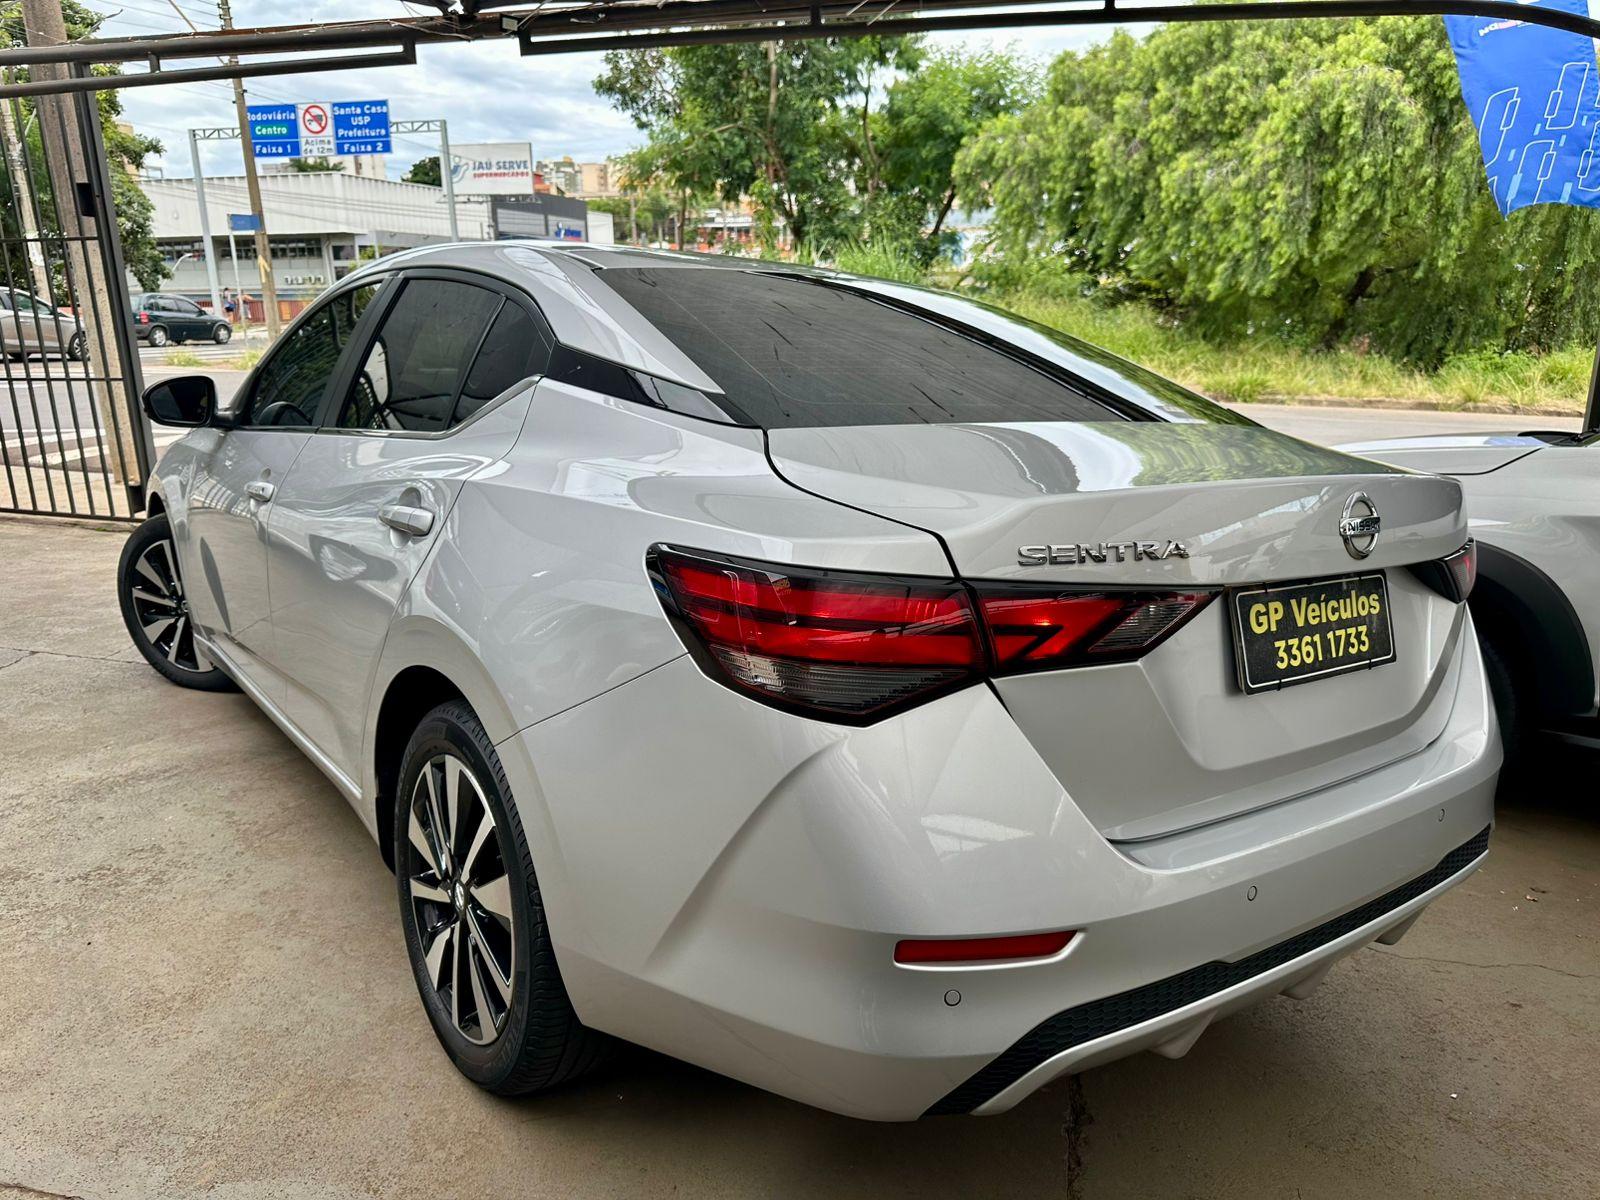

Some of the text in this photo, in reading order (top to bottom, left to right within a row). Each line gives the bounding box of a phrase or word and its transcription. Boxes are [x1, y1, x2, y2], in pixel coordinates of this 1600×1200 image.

[333, 104, 387, 115] Santa Casa
[350, 115, 371, 125] USP
[255, 126, 287, 135] Centro
[337, 127, 386, 138] Prefeitura
[304, 138, 332, 146] Acima
[343, 142, 383, 153] Faixa 2
[255, 143, 292, 154] Faixa 1
[496, 160, 529, 170] SERVE
[1017, 539, 1190, 567] SENTRA
[1250, 590, 1380, 634] GP Veículos
[1274, 625, 1370, 670] 3361 1733
